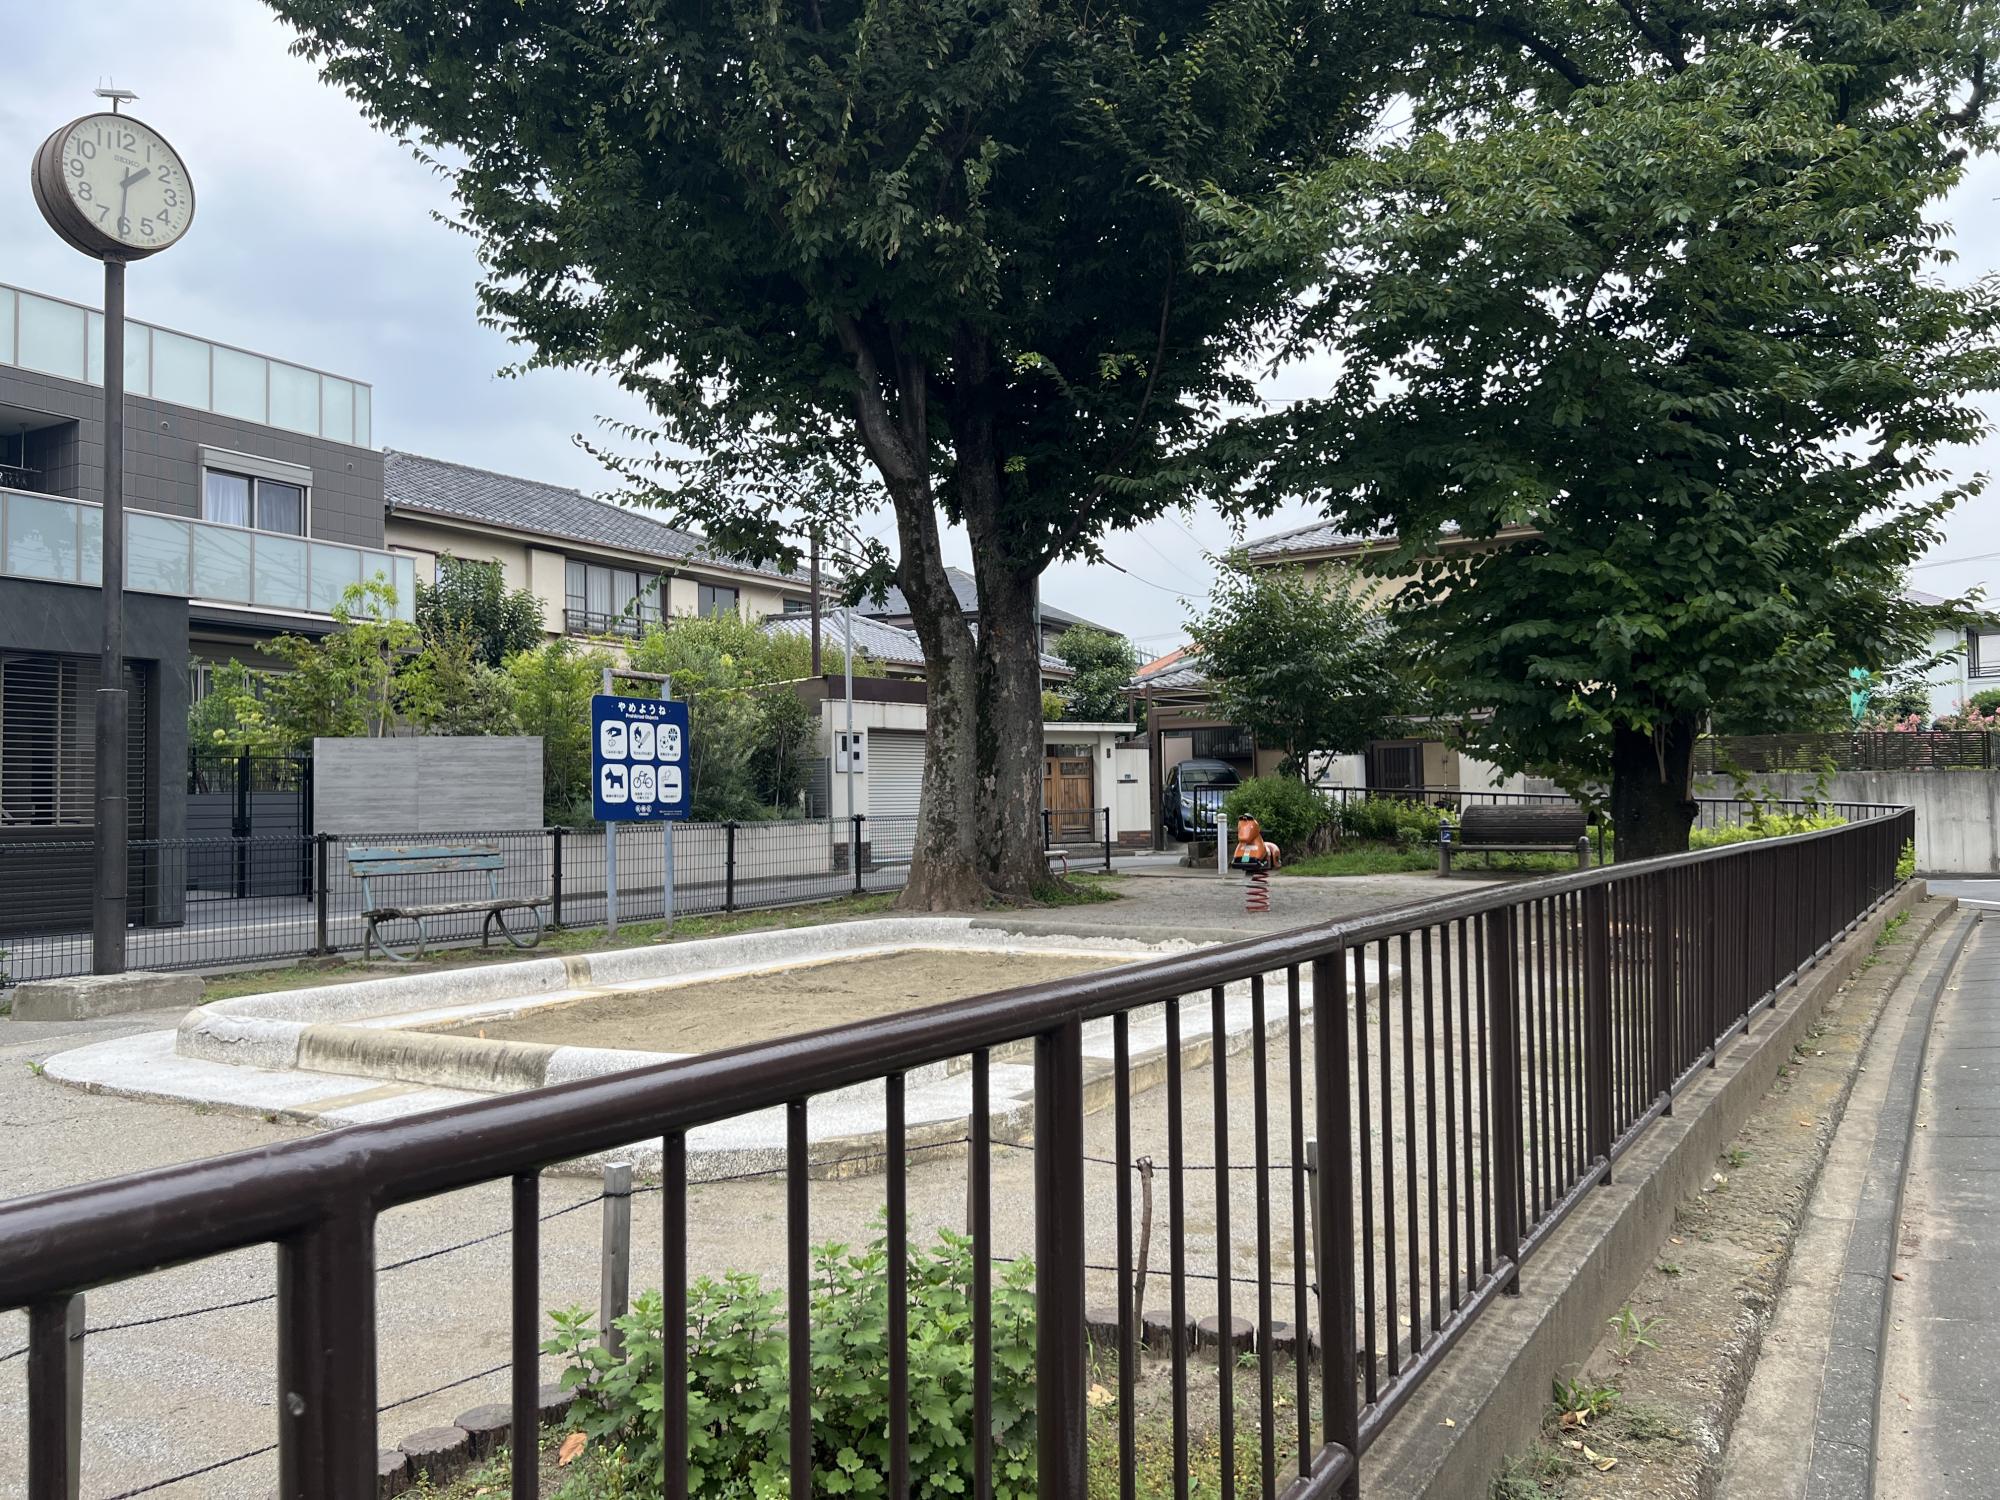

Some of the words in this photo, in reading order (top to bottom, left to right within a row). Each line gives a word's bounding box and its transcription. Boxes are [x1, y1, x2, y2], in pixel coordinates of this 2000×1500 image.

[97, 128, 111, 149] 11
[117, 130, 136, 153] 12
[77, 138, 96, 159] 10
[70, 159, 84, 178] 9
[114, 154, 140, 168] SEIKO
[158, 165, 171, 184] 2
[78, 181, 92, 201] 8
[163, 188, 177, 207] 3
[96, 203, 110, 222] 7
[157, 209, 171, 226] 4
[117, 216, 131, 236] 6
[140, 217, 154, 236] 5
[618, 702, 666, 715] やめようね
